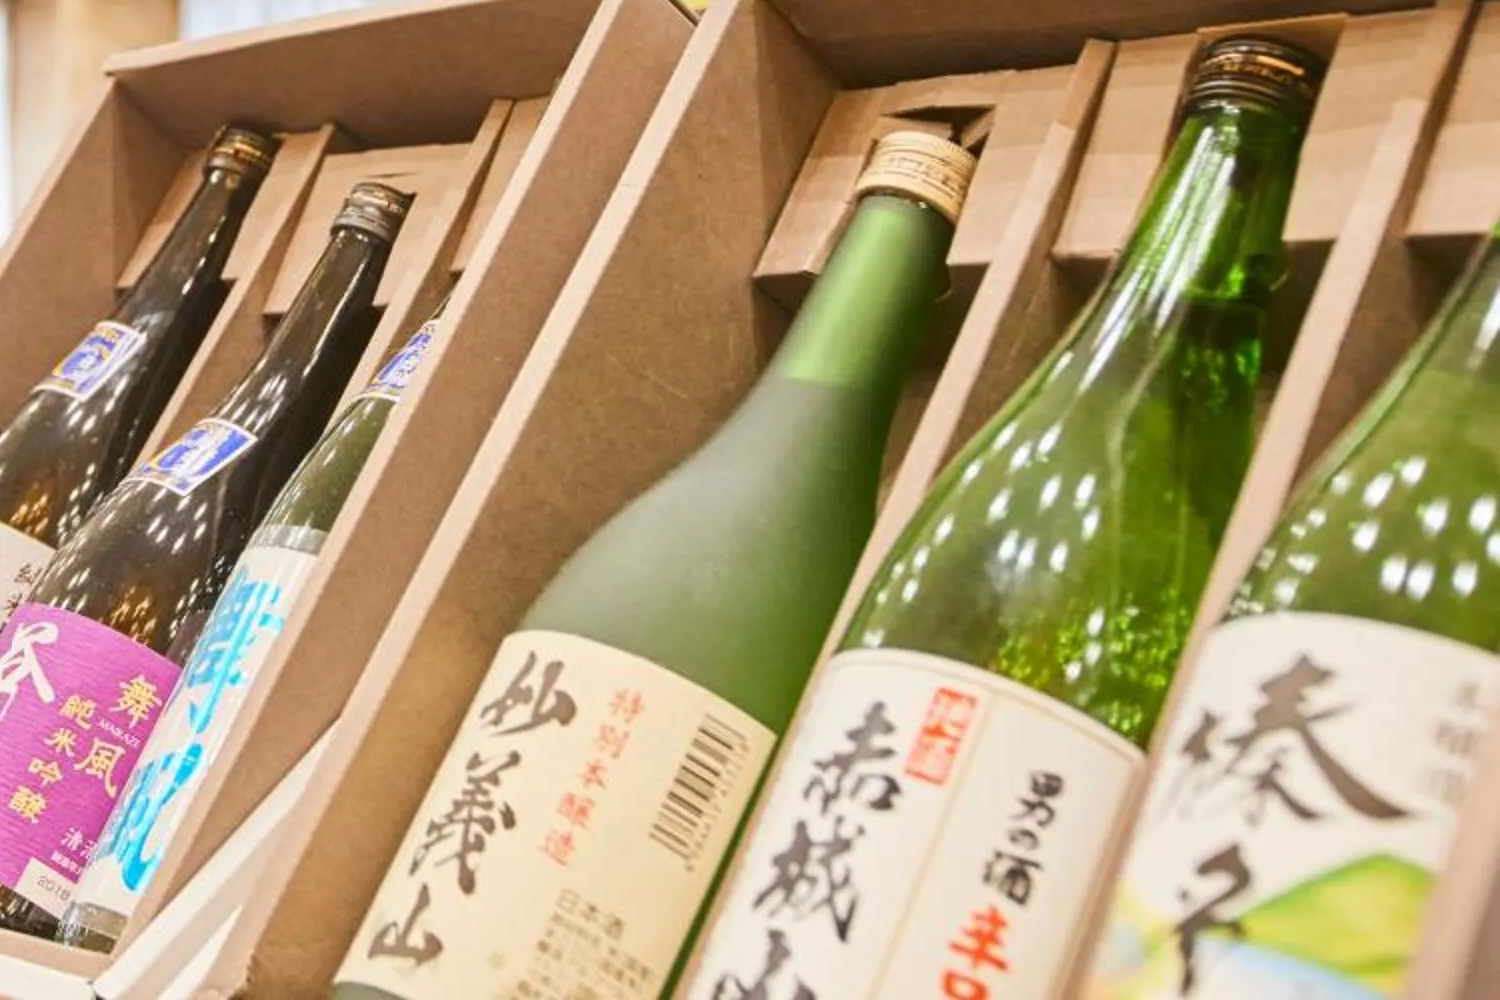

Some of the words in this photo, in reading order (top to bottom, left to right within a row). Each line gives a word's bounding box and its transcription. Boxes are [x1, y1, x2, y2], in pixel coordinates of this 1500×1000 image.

[7, 694, 98, 825] 純米吟醸
[73, 673, 163, 799] 舞風
[538, 685, 647, 869] 特別本醸造
[367, 649, 578, 968] 妙義山
[983, 770, 1065, 907] 男の酒
[942, 903, 1010, 1000] 辛口
